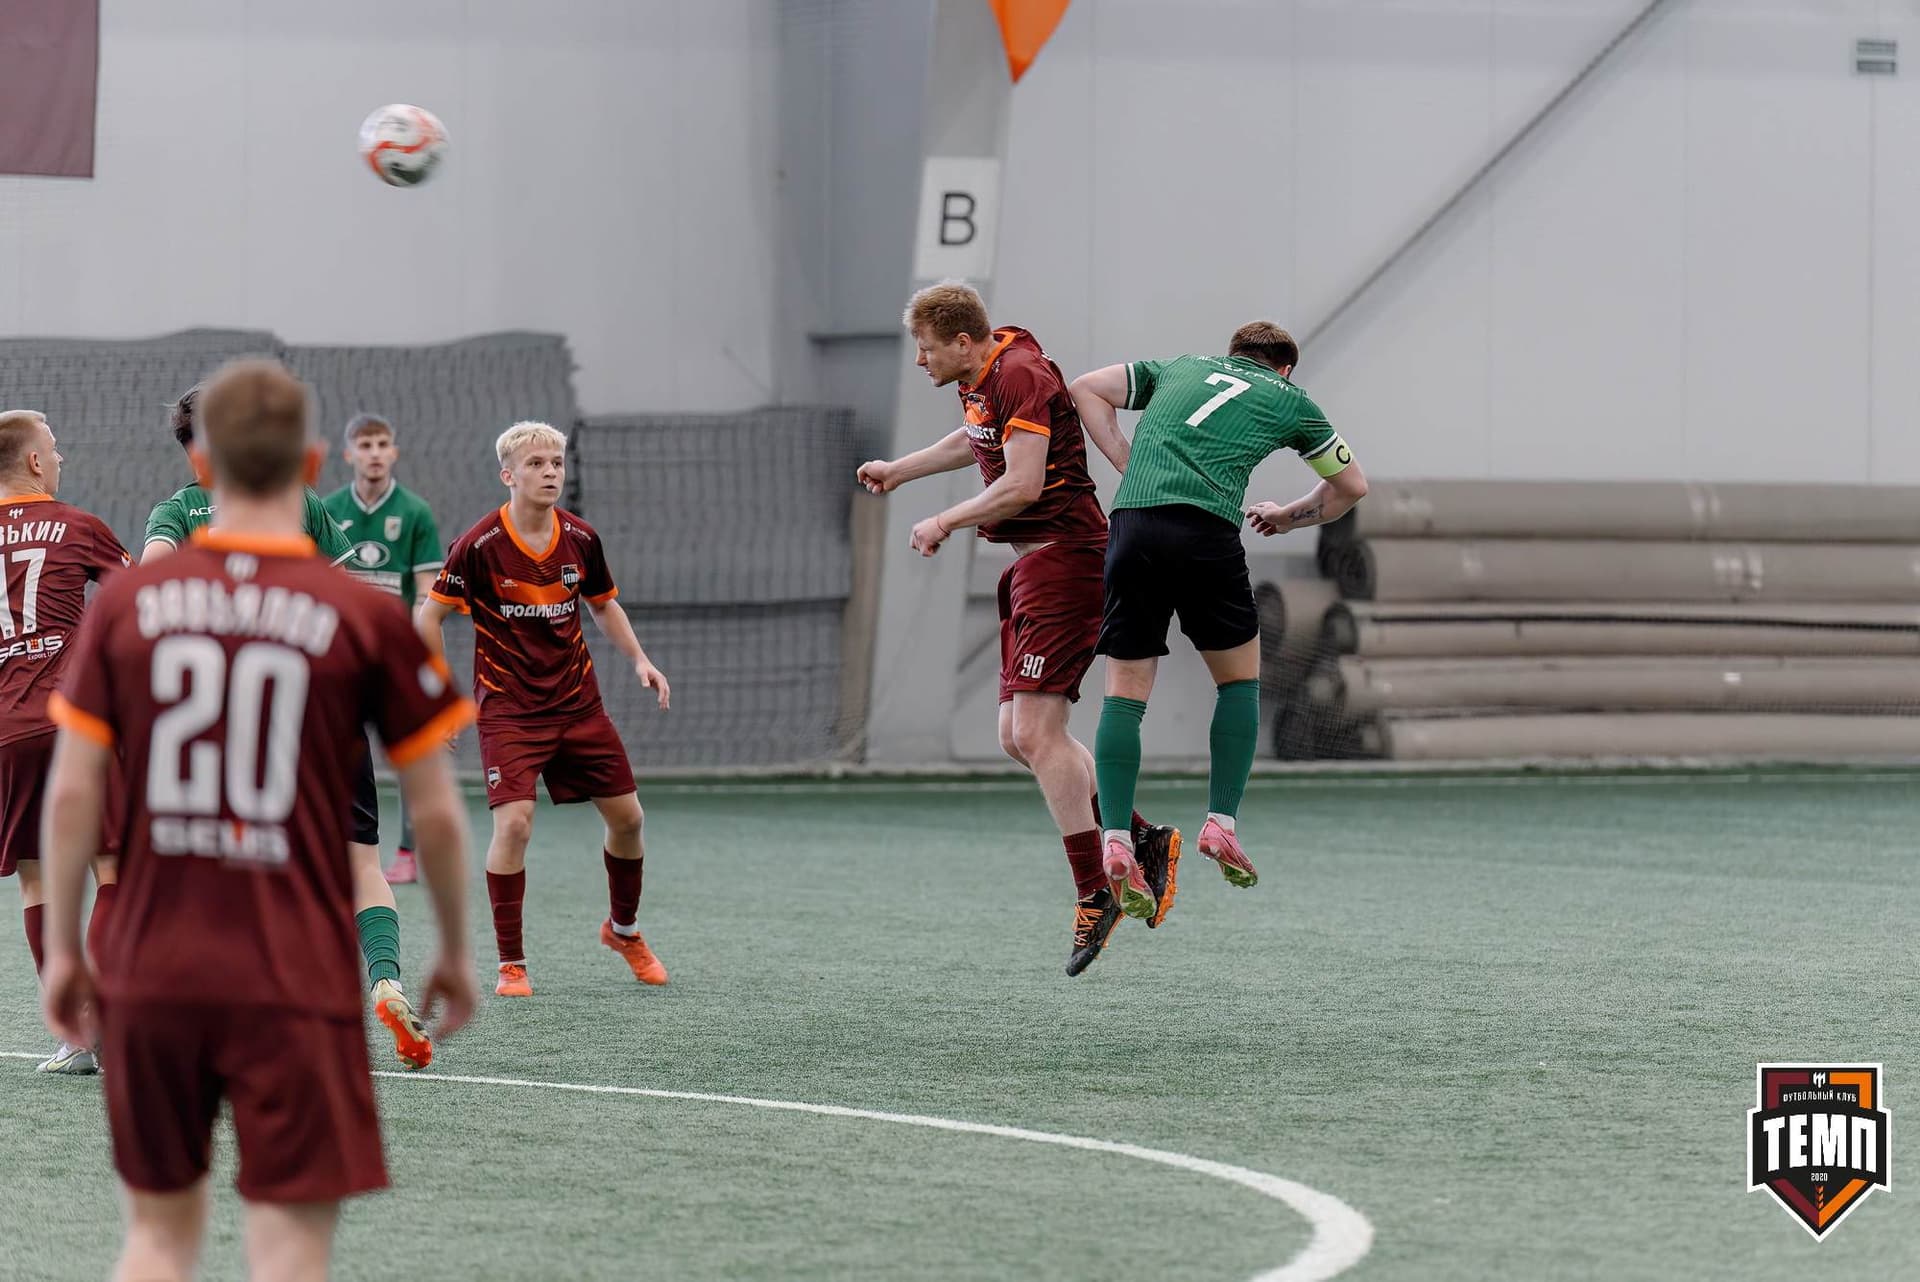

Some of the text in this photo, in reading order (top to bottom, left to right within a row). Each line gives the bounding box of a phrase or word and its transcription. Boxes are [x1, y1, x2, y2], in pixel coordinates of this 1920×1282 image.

[1184, 372, 1252, 428] 7
[1020, 653, 1046, 679] 90
[146, 633, 310, 823] 20
